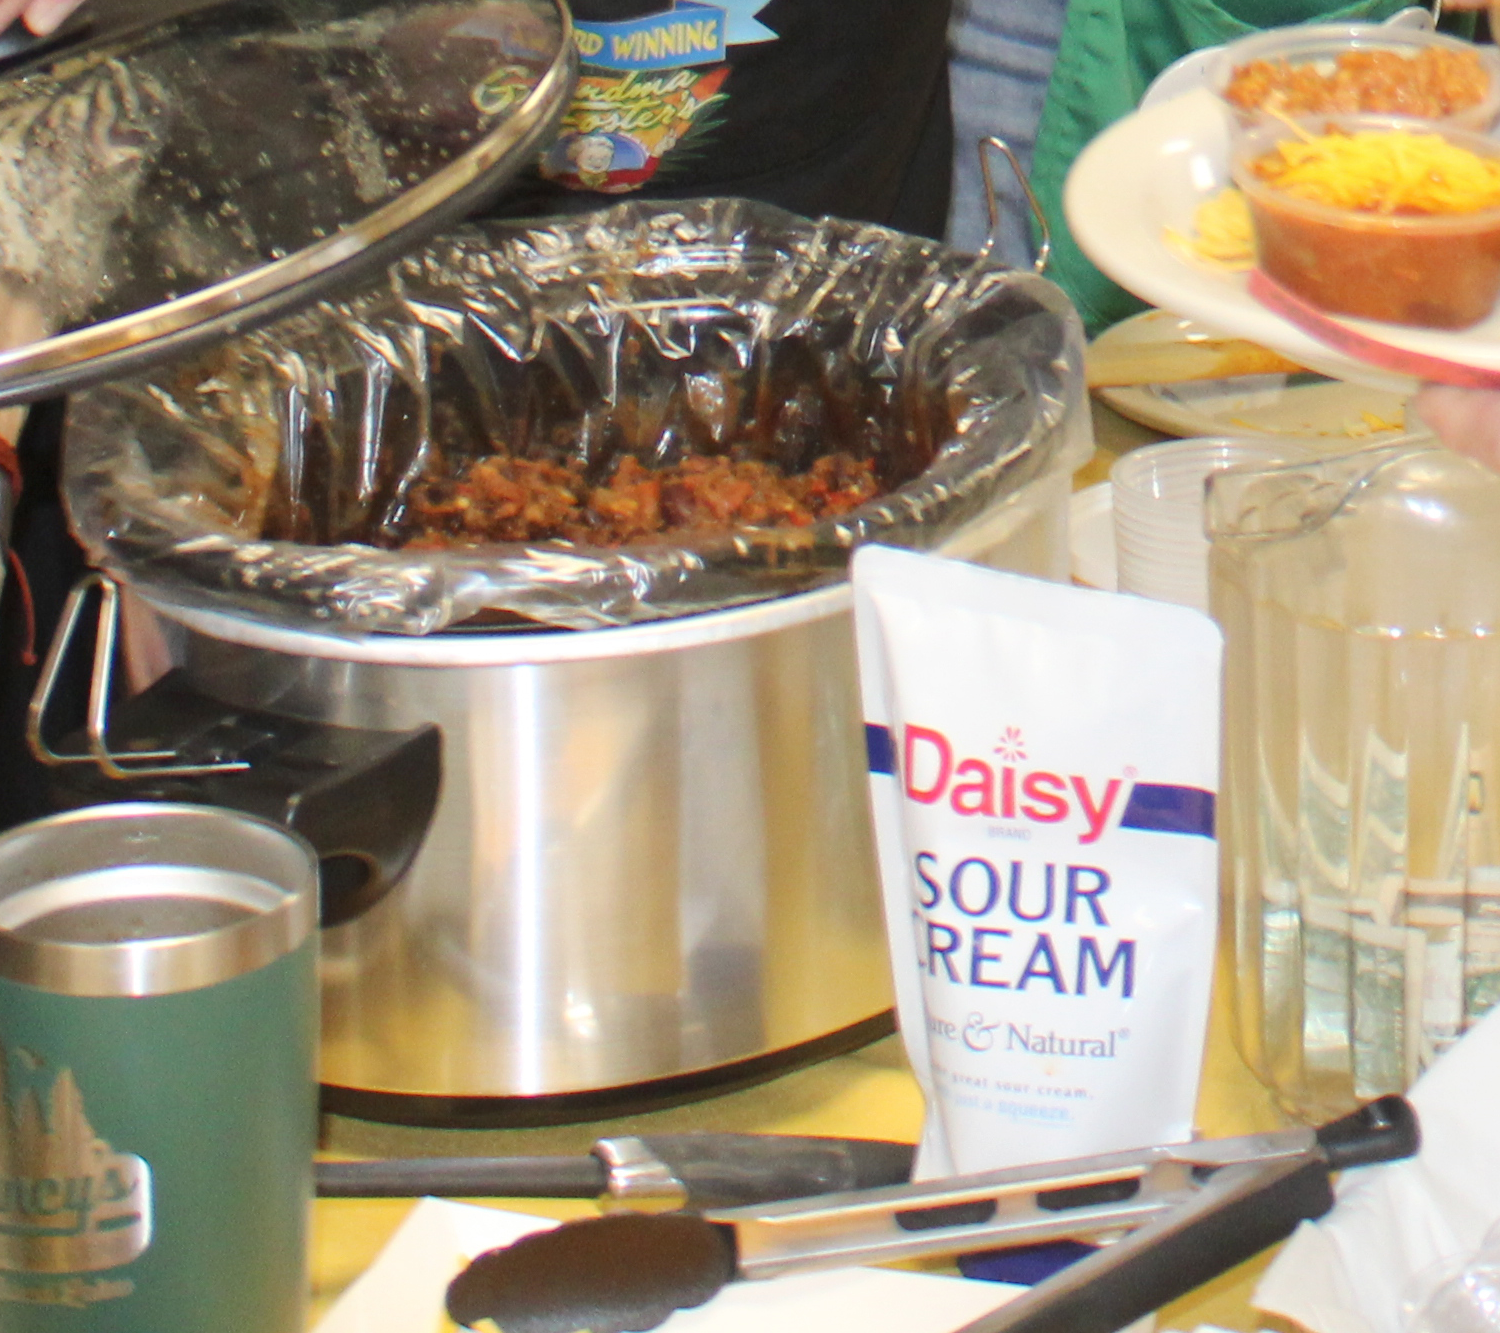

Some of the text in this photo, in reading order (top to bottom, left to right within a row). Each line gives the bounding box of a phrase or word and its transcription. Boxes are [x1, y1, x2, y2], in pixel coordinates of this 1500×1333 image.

[611, 18, 719, 62] WINNING
[902, 722, 1123, 845] Daisy
[987, 825, 1032, 842] BRAND
[914, 850, 1111, 927] SOUR
[928, 1011, 1116, 1058] ure & Natural
[996, 1080, 1031, 1094] sour
